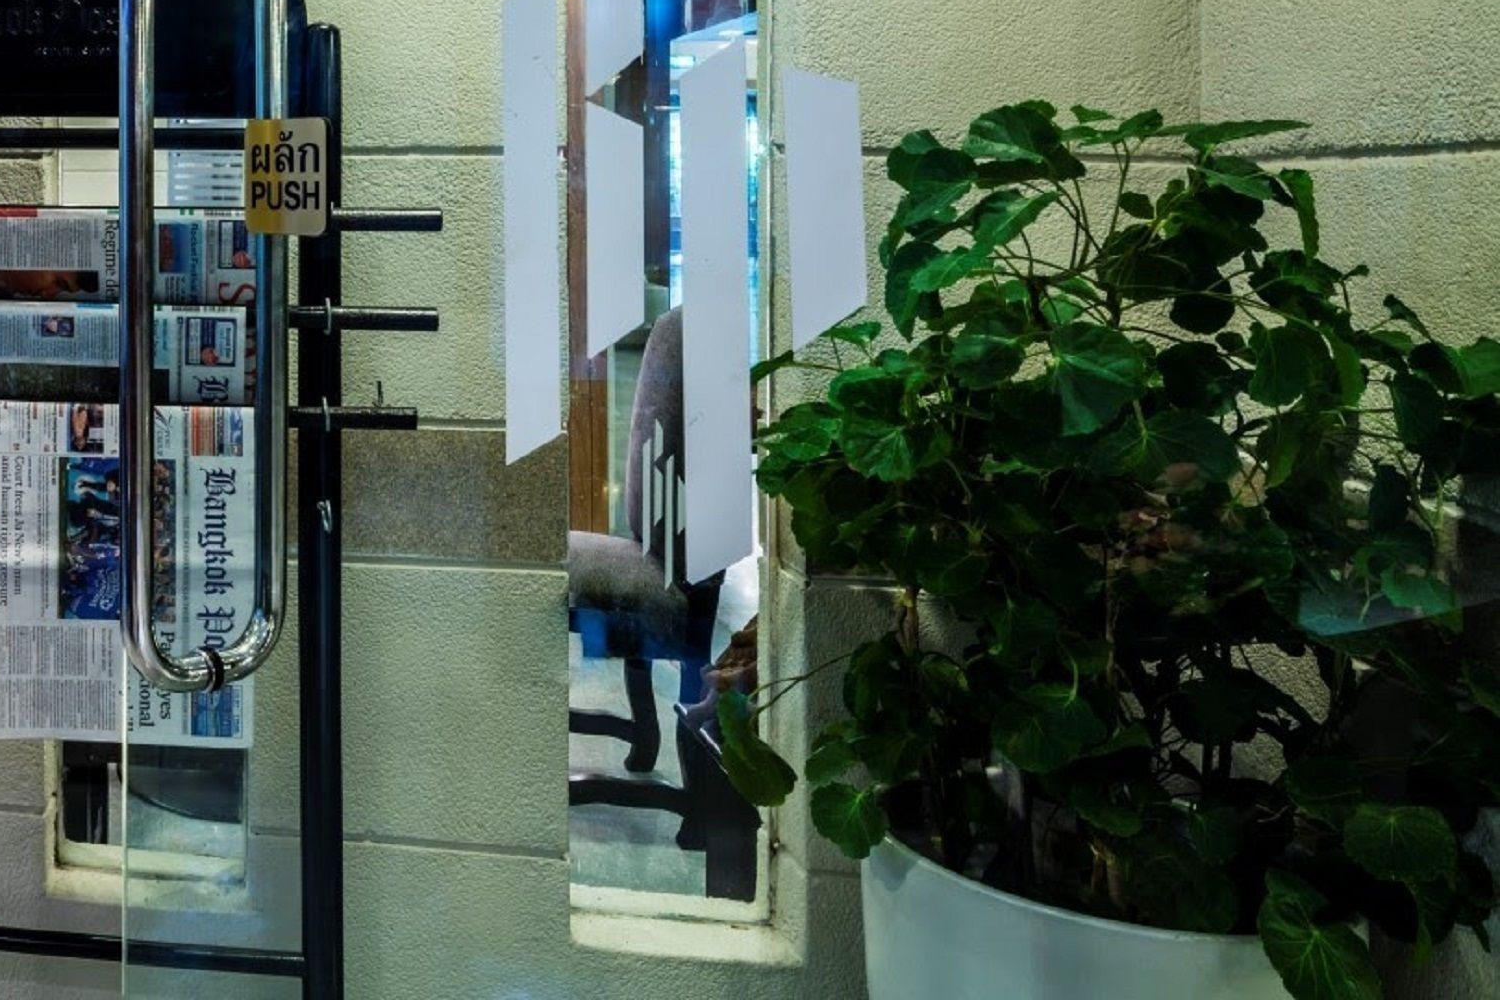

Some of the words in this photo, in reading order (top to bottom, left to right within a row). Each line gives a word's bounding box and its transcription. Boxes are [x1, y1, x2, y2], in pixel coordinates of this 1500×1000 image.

[251, 131, 320, 174] ผลัก
[251, 181, 320, 210] PUSH
[100, 220, 120, 277] Regime
[0, 456, 12, 482] amid
[14, 456, 26, 487] Court
[0, 486, 12, 524] human
[14, 490, 26, 515] frees
[198, 467, 237, 595] Bangkok
